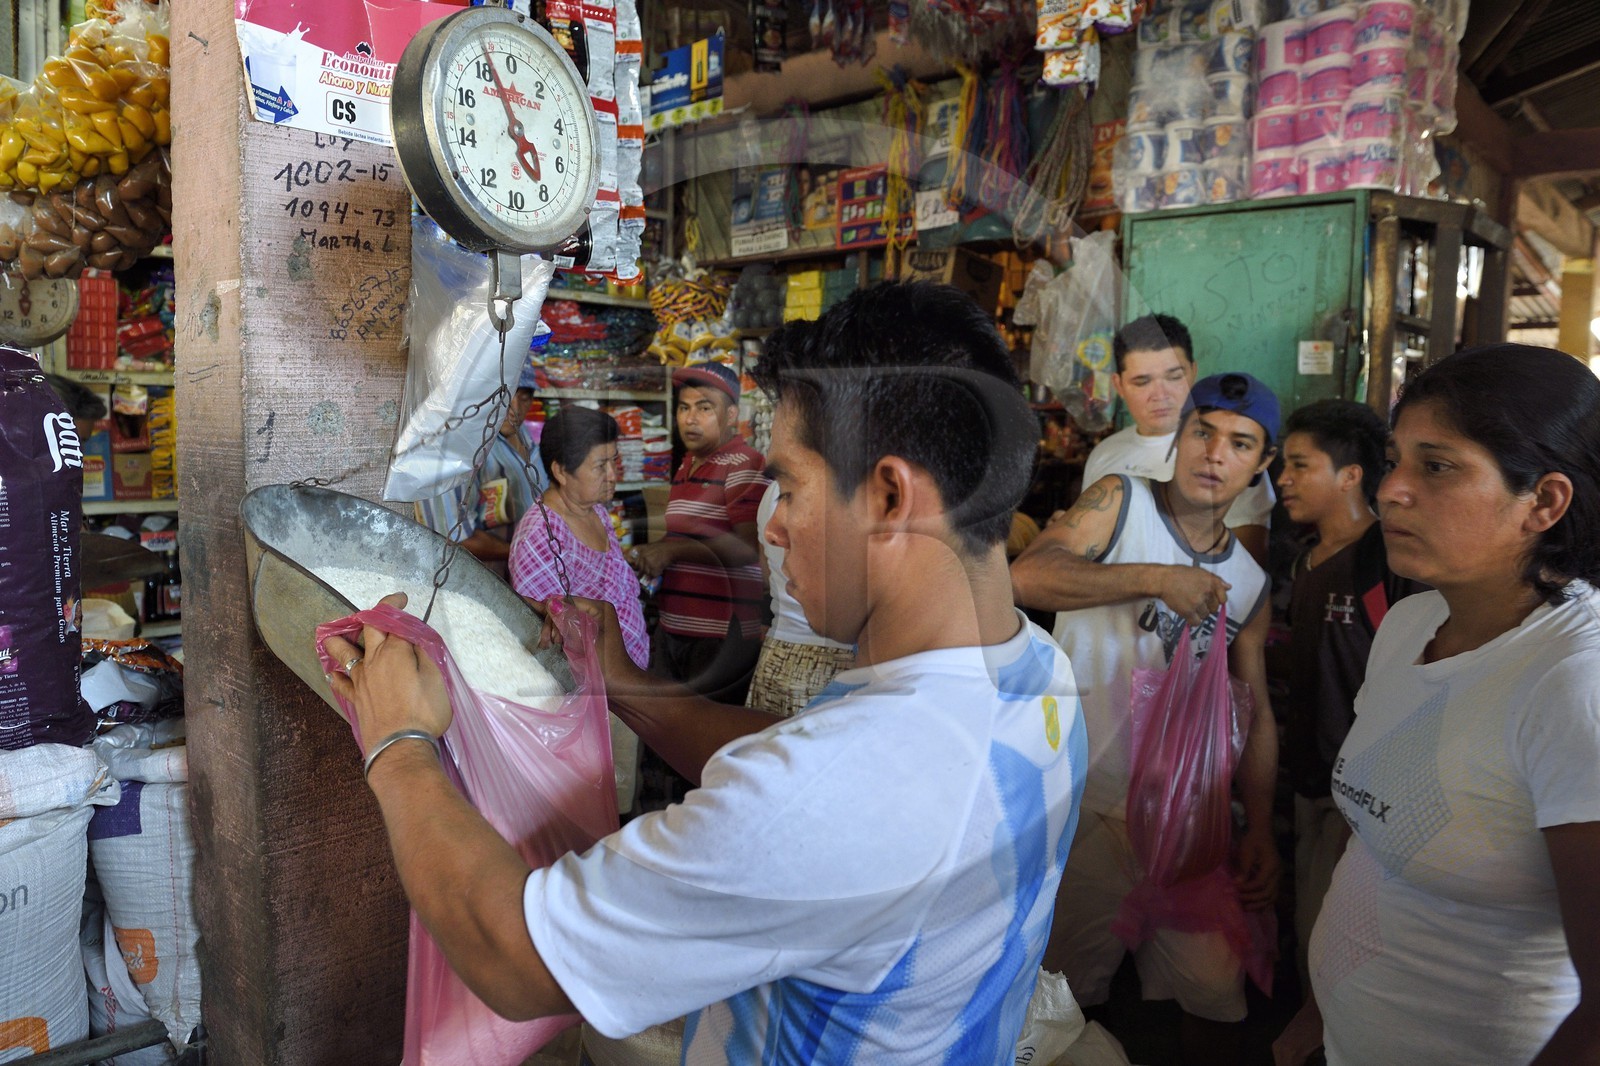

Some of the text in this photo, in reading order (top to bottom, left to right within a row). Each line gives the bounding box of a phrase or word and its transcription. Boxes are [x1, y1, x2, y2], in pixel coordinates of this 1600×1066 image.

[476, 61, 493, 83] 18
[506, 56, 517, 75] 0
[319, 71, 354, 90] Ahorro
[356, 81, 365, 95] y
[534, 81, 545, 99] 2
[458, 87, 475, 108] 16
[332, 98, 356, 124] C$
[553, 118, 564, 135] 4
[459, 127, 477, 148] 14
[555, 156, 564, 174] 6
[480, 168, 497, 188] 12
[508, 190, 525, 210] 10
[539, 184, 550, 202] 8
[4, 310, 14, 319] 12
[52, 300, 58, 309] 6
[21, 319, 31, 328] 10
[59, 510, 72, 578] Mar y Tierra
[50, 512, 66, 643] Alimento Premium para Gatos
